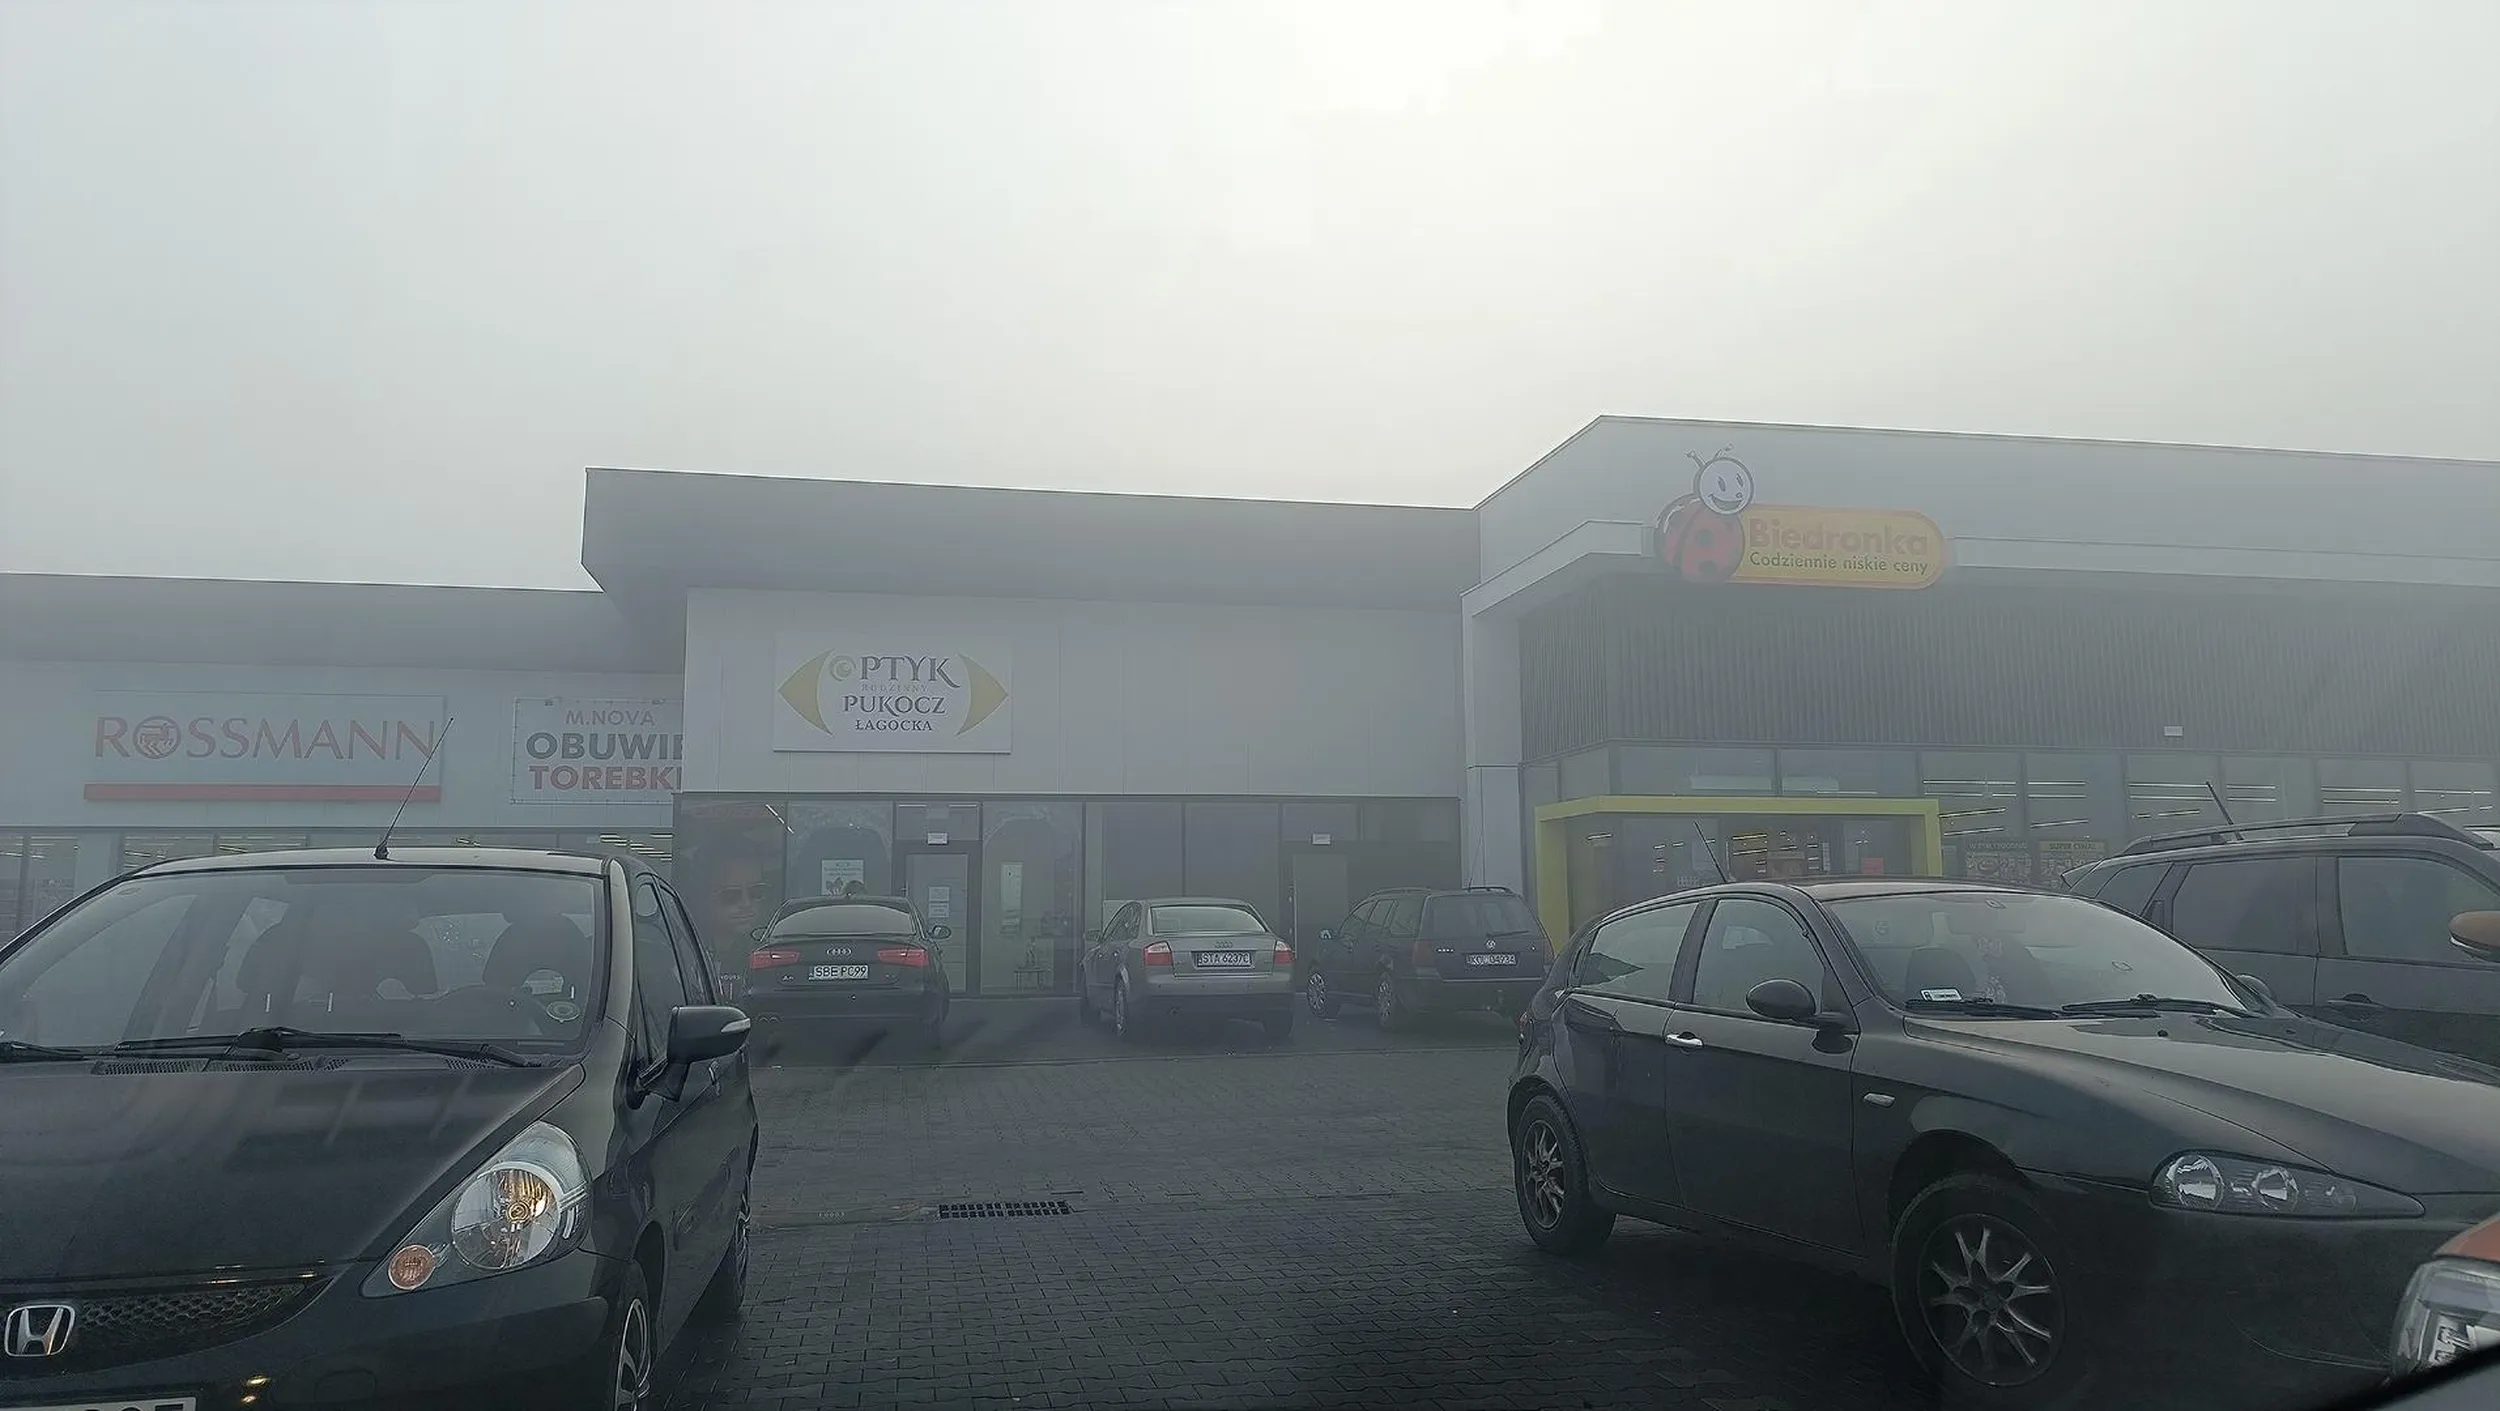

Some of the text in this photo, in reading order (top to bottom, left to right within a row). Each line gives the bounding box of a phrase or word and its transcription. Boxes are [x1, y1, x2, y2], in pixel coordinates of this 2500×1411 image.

[1749, 519, 1928, 555] Biedronka
[1749, 551, 1929, 575] Codziennie niskie ceny
[843, 695, 946, 717] PUKOCZ
[565, 710, 657, 726] M.NOVA
[854, 719, 933, 732] ŁAGOCKA
[94, 715, 436, 760] ROSSMANN
[815, 966, 839, 978] SBE
